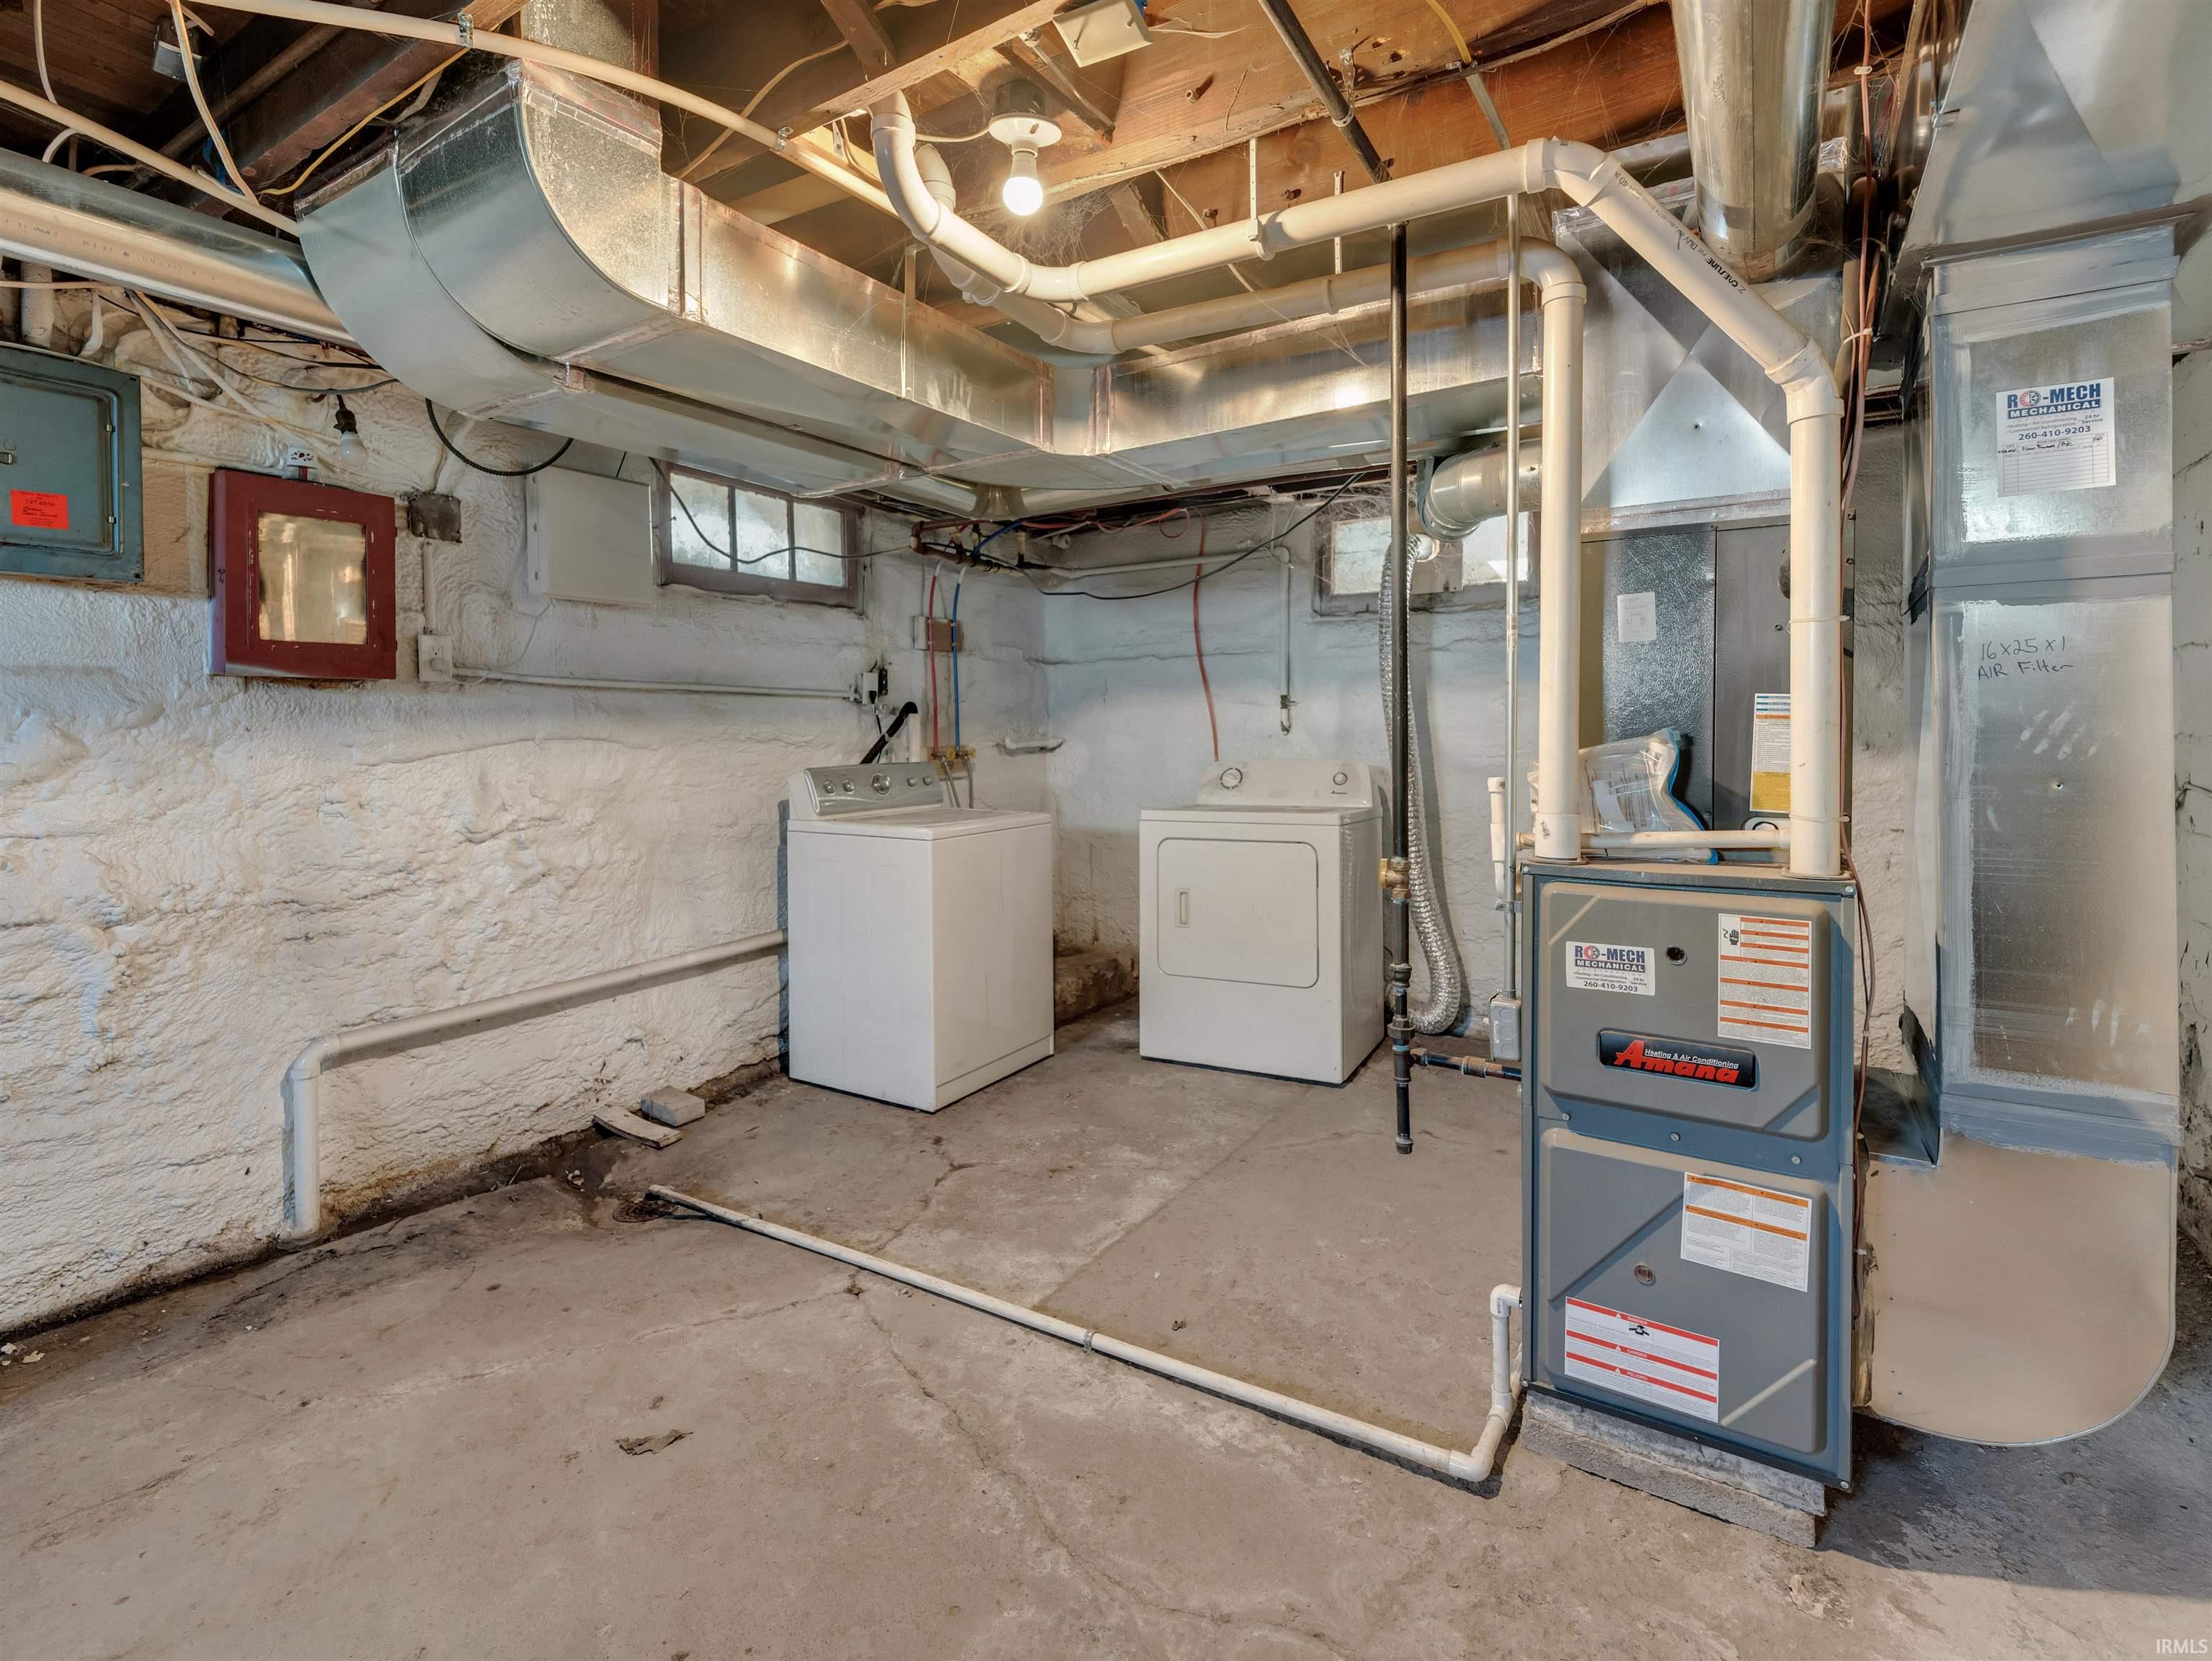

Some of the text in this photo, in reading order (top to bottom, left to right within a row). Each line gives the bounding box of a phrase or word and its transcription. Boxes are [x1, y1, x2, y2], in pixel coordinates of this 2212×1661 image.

[1619, 177, 1629, 187] 40
[2009, 401, 2100, 418] MECHANICAL
[2019, 426, 2091, 440] 260-410-9203
[1978, 659, 2075, 681] AIR Filter
[1576, 960, 1645, 972] MECHANICAL
[1584, 980, 1638, 992] 260-410-9203
[1614, 1040, 1740, 1084] Amana
[1645, 1049, 1671, 1060] Heating
[1693, 1056, 1739, 1069] Conditioning
[1627, 1316, 1648, 1326] DANGER
[1627, 1349, 1648, 1359] DANGER
